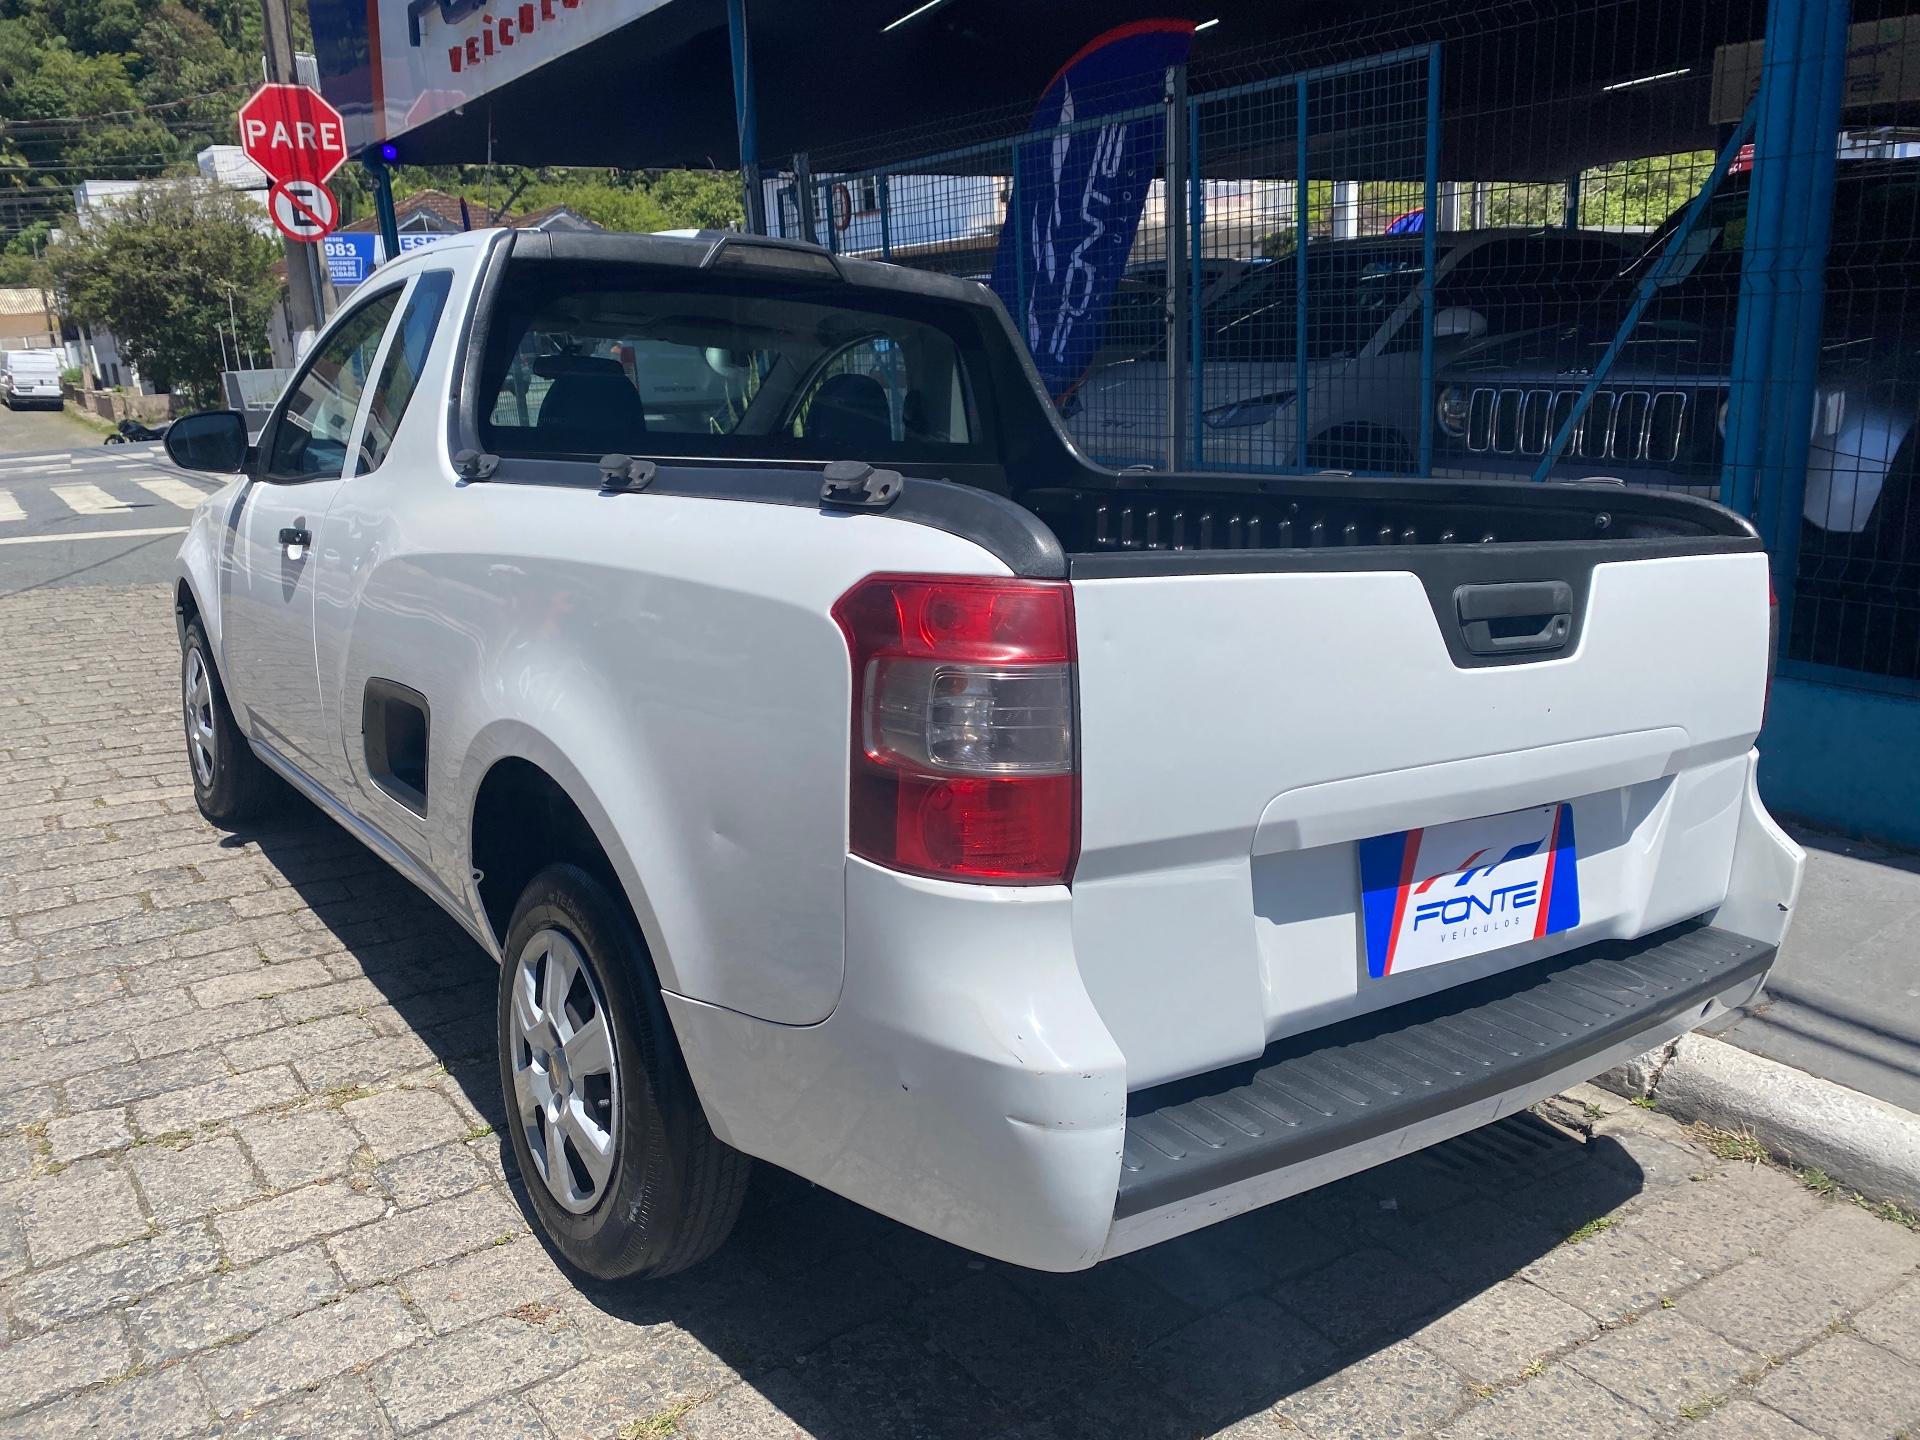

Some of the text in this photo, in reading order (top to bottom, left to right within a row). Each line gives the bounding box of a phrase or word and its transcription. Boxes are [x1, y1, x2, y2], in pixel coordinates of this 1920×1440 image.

[246, 119, 340, 151] PARE
[289, 189, 317, 227] E
[324, 243, 357, 256] 983
[1413, 880, 1538, 932] FONTE
